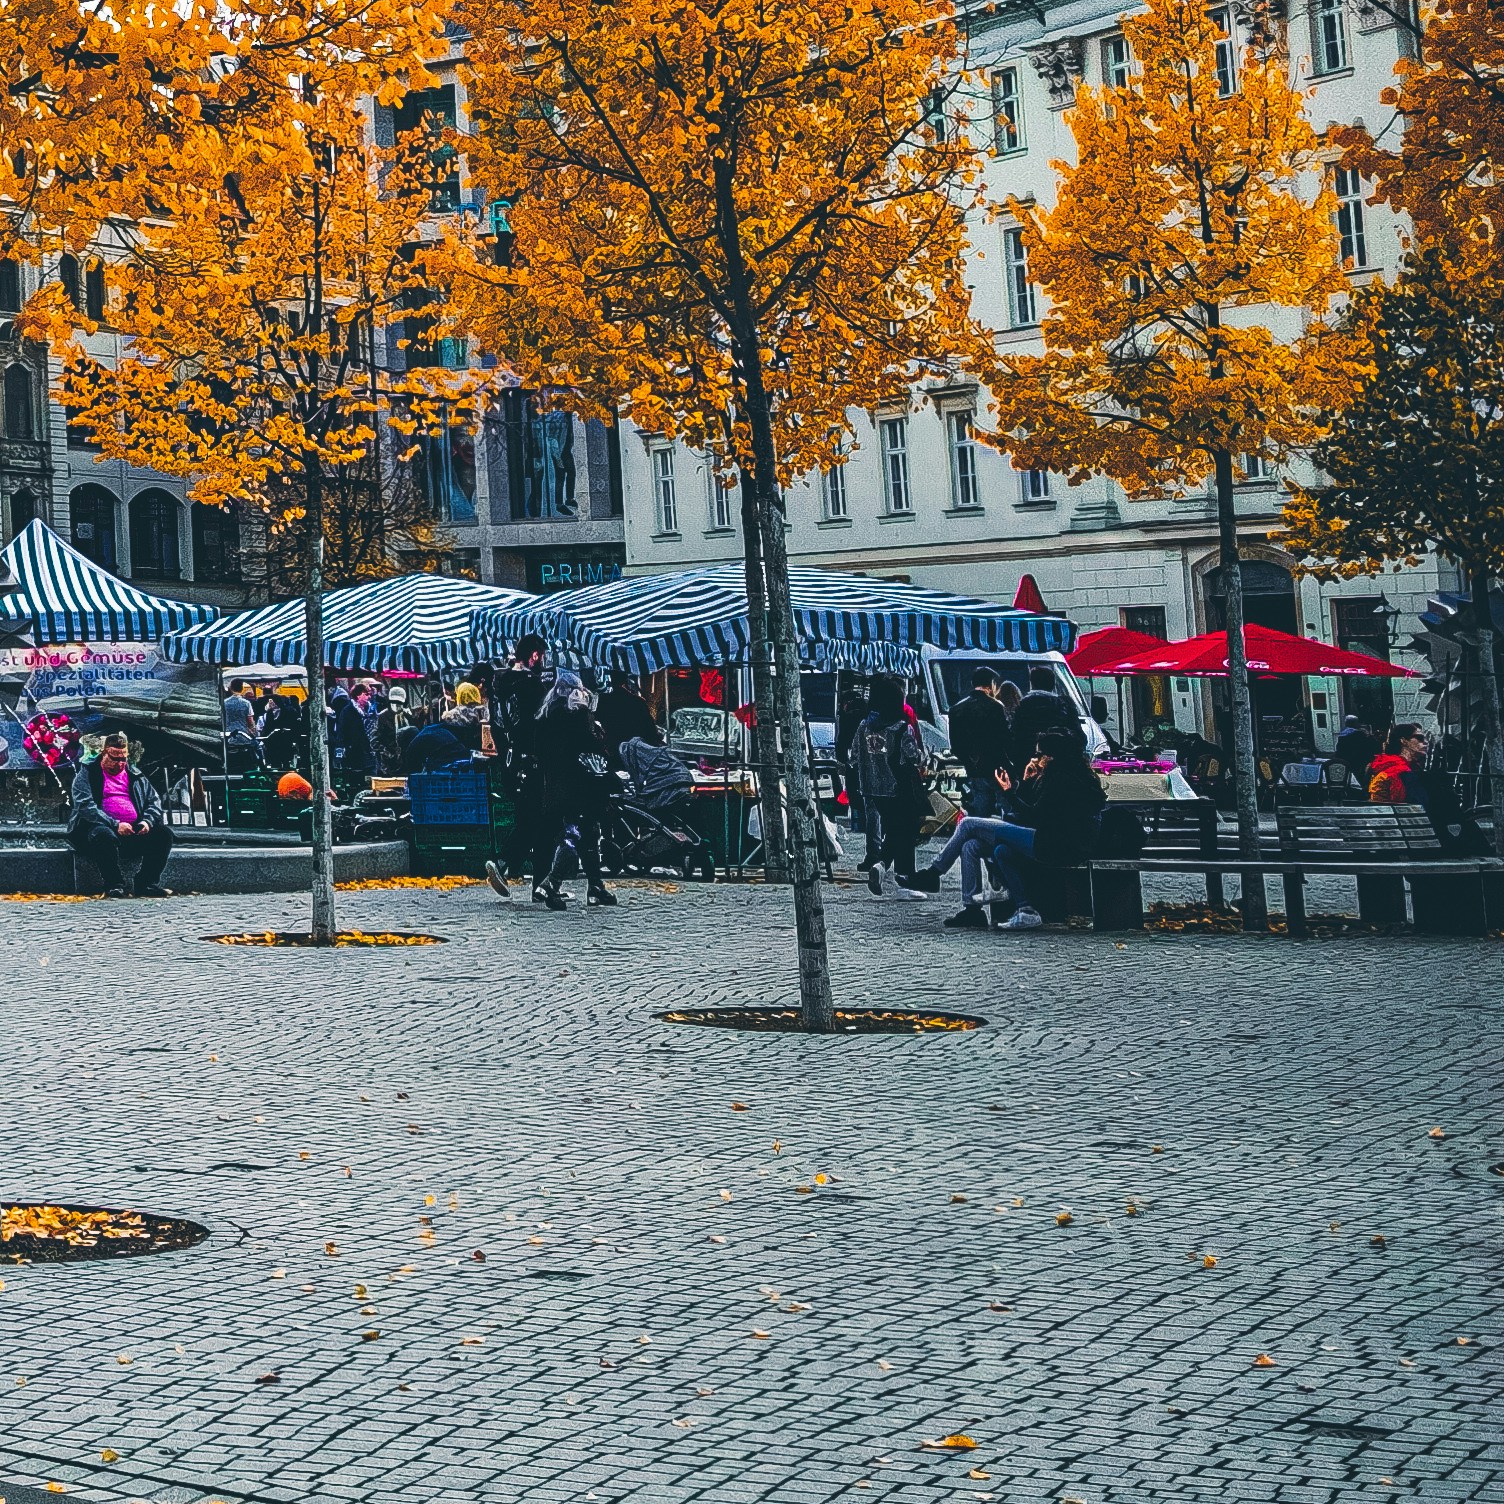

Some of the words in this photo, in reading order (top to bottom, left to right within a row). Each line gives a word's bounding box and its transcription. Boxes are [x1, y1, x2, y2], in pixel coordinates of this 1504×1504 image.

[24, 652, 61, 666] und
[66, 651, 147, 665] Gemüse
[35, 667, 156, 683] Spezialitäten
[55, 685, 107, 696] Polen
